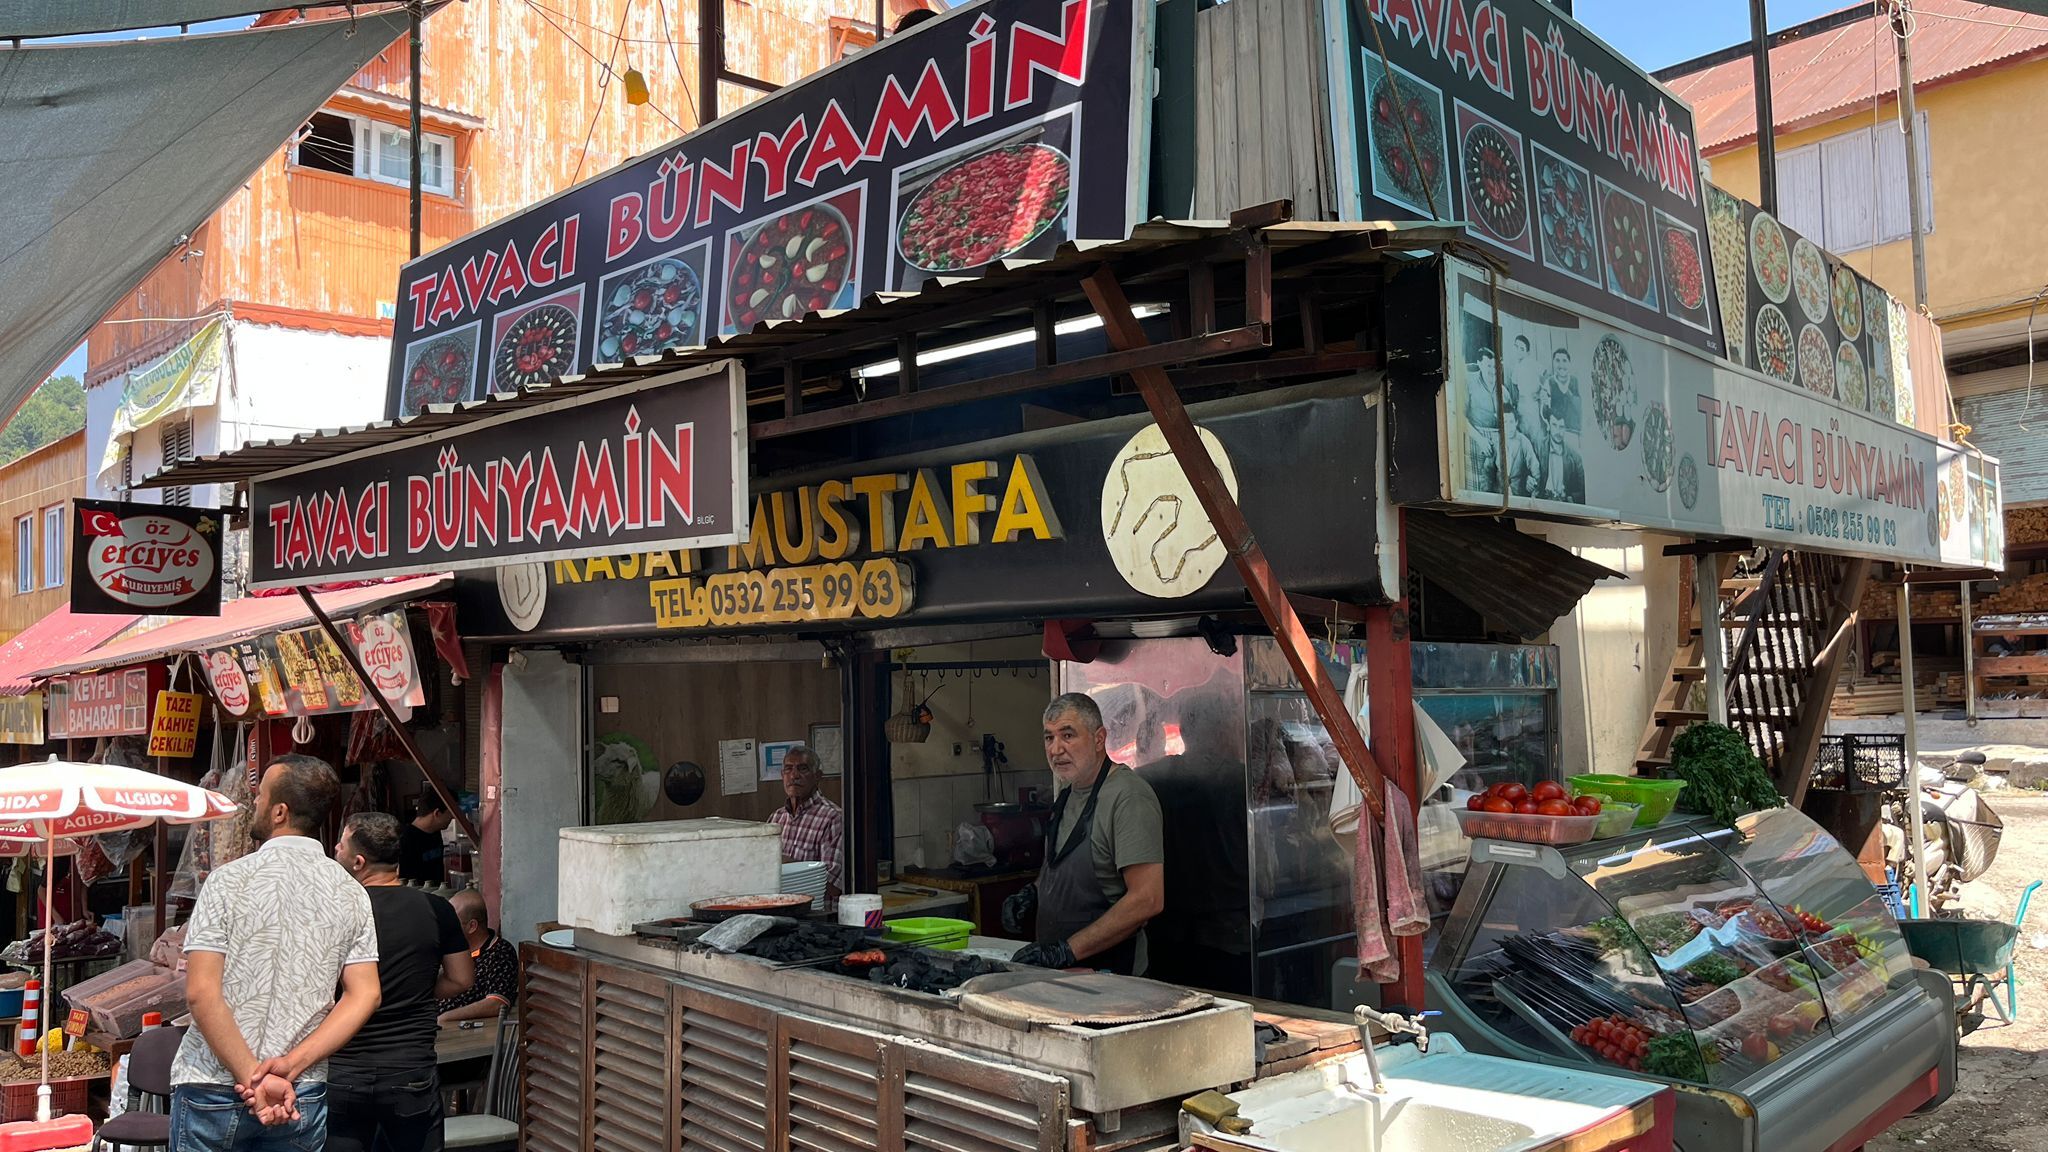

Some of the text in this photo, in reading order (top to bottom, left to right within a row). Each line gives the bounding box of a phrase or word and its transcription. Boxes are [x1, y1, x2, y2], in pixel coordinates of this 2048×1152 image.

[1370, 0, 1697, 207] AVACI BÜNYAMİN
[410, 0, 1091, 332] TAVACI BÜNYAMİN
[1697, 394, 1926, 513] TAVACI BÜNYAMİN
[269, 403, 695, 571] TAVACI BÜNYAMİN
[1806, 504, 1839, 539] 0532
[1842, 511, 1864, 543] 255
[1867, 515, 1881, 546] 99
[1883, 518, 1897, 547] 63
[101, 538, 200, 574] erciyes
[121, 578, 182, 593] KURUYEMİŞ
[710, 581, 765, 616] 0532
[770, 578, 814, 610] 255
[822, 574, 854, 607] 99
[861, 570, 895, 605] 63
[69, 704, 122, 732] BAHARAT
[157, 716, 196, 733] KAHVE
[165, 696, 193, 713] TAZE
